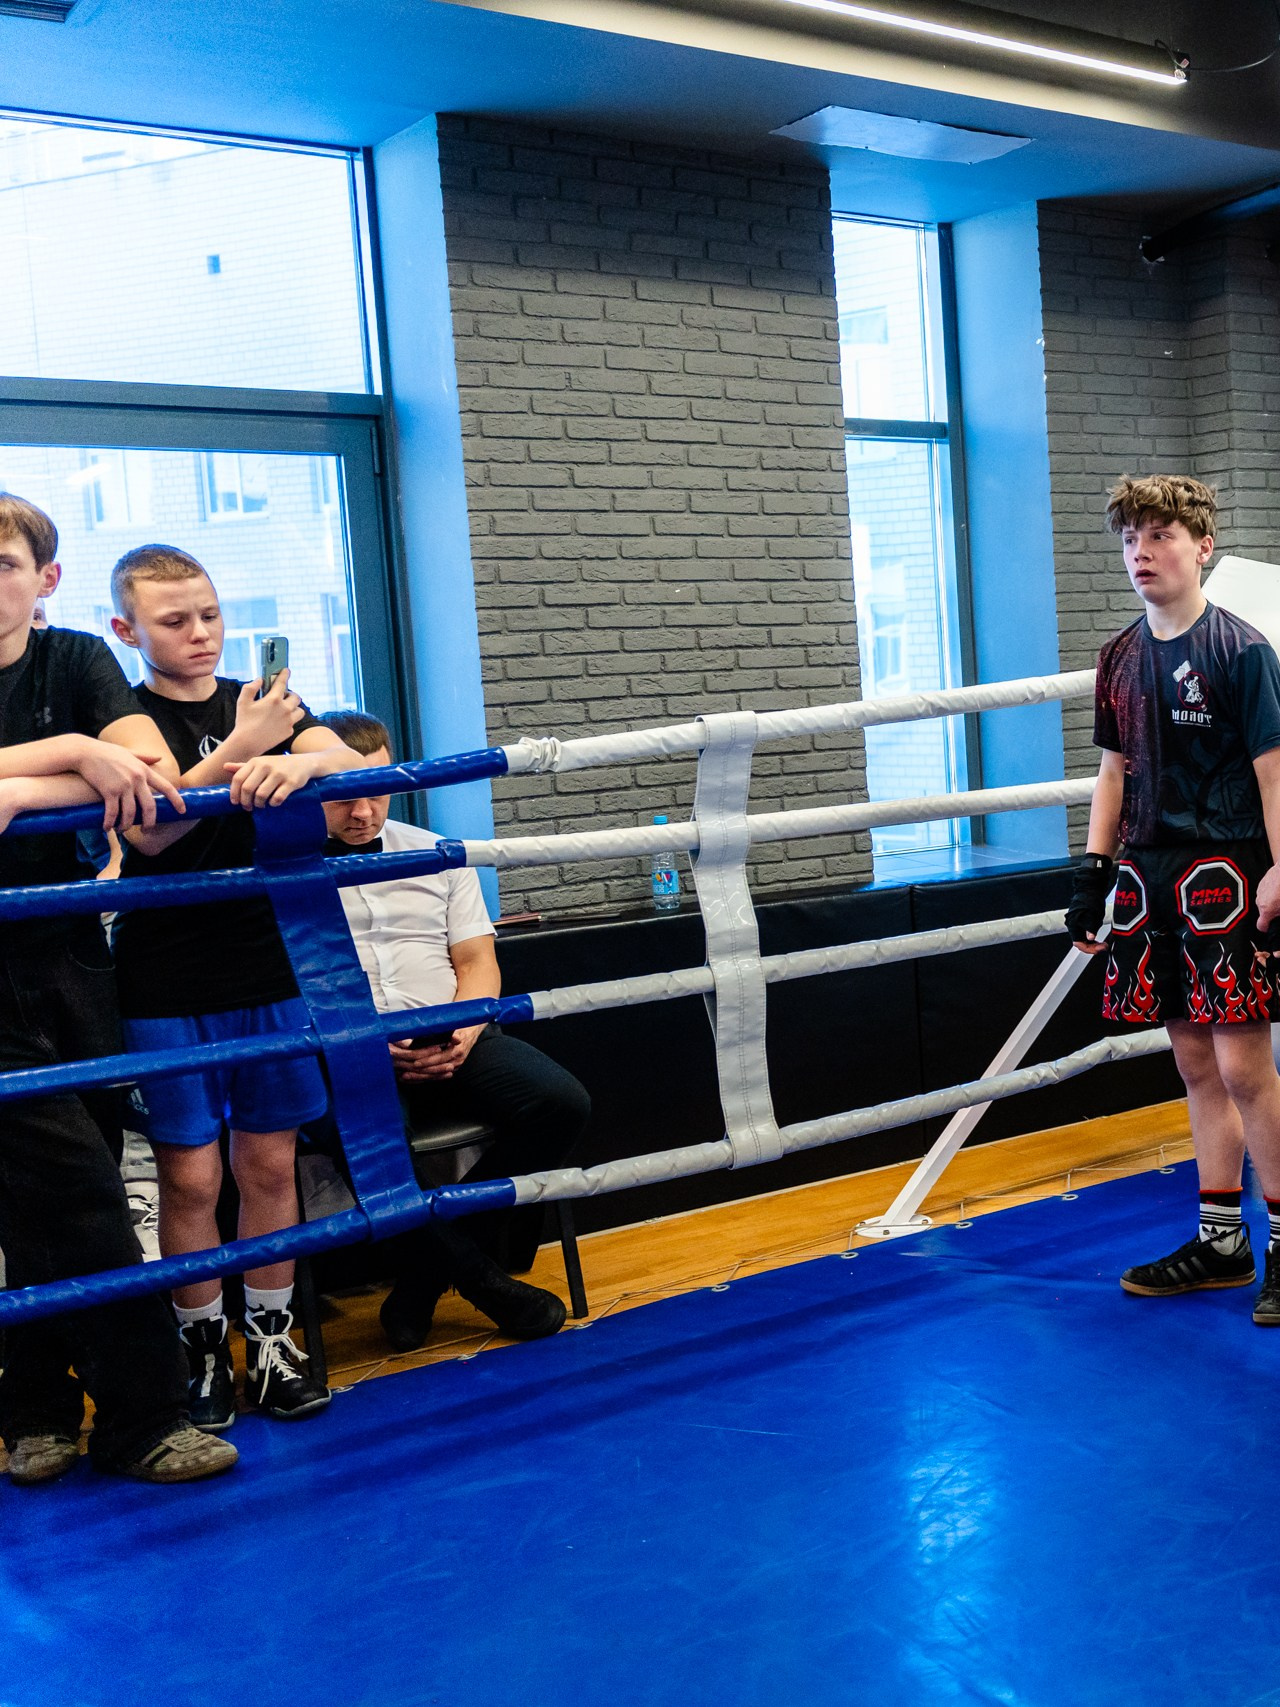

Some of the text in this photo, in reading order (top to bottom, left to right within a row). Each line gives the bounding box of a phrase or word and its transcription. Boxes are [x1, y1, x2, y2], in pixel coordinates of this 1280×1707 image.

[1115, 890, 1137, 901] MA
[1191, 887, 1232, 900] MMA
[1190, 896, 1232, 907] SERIES
